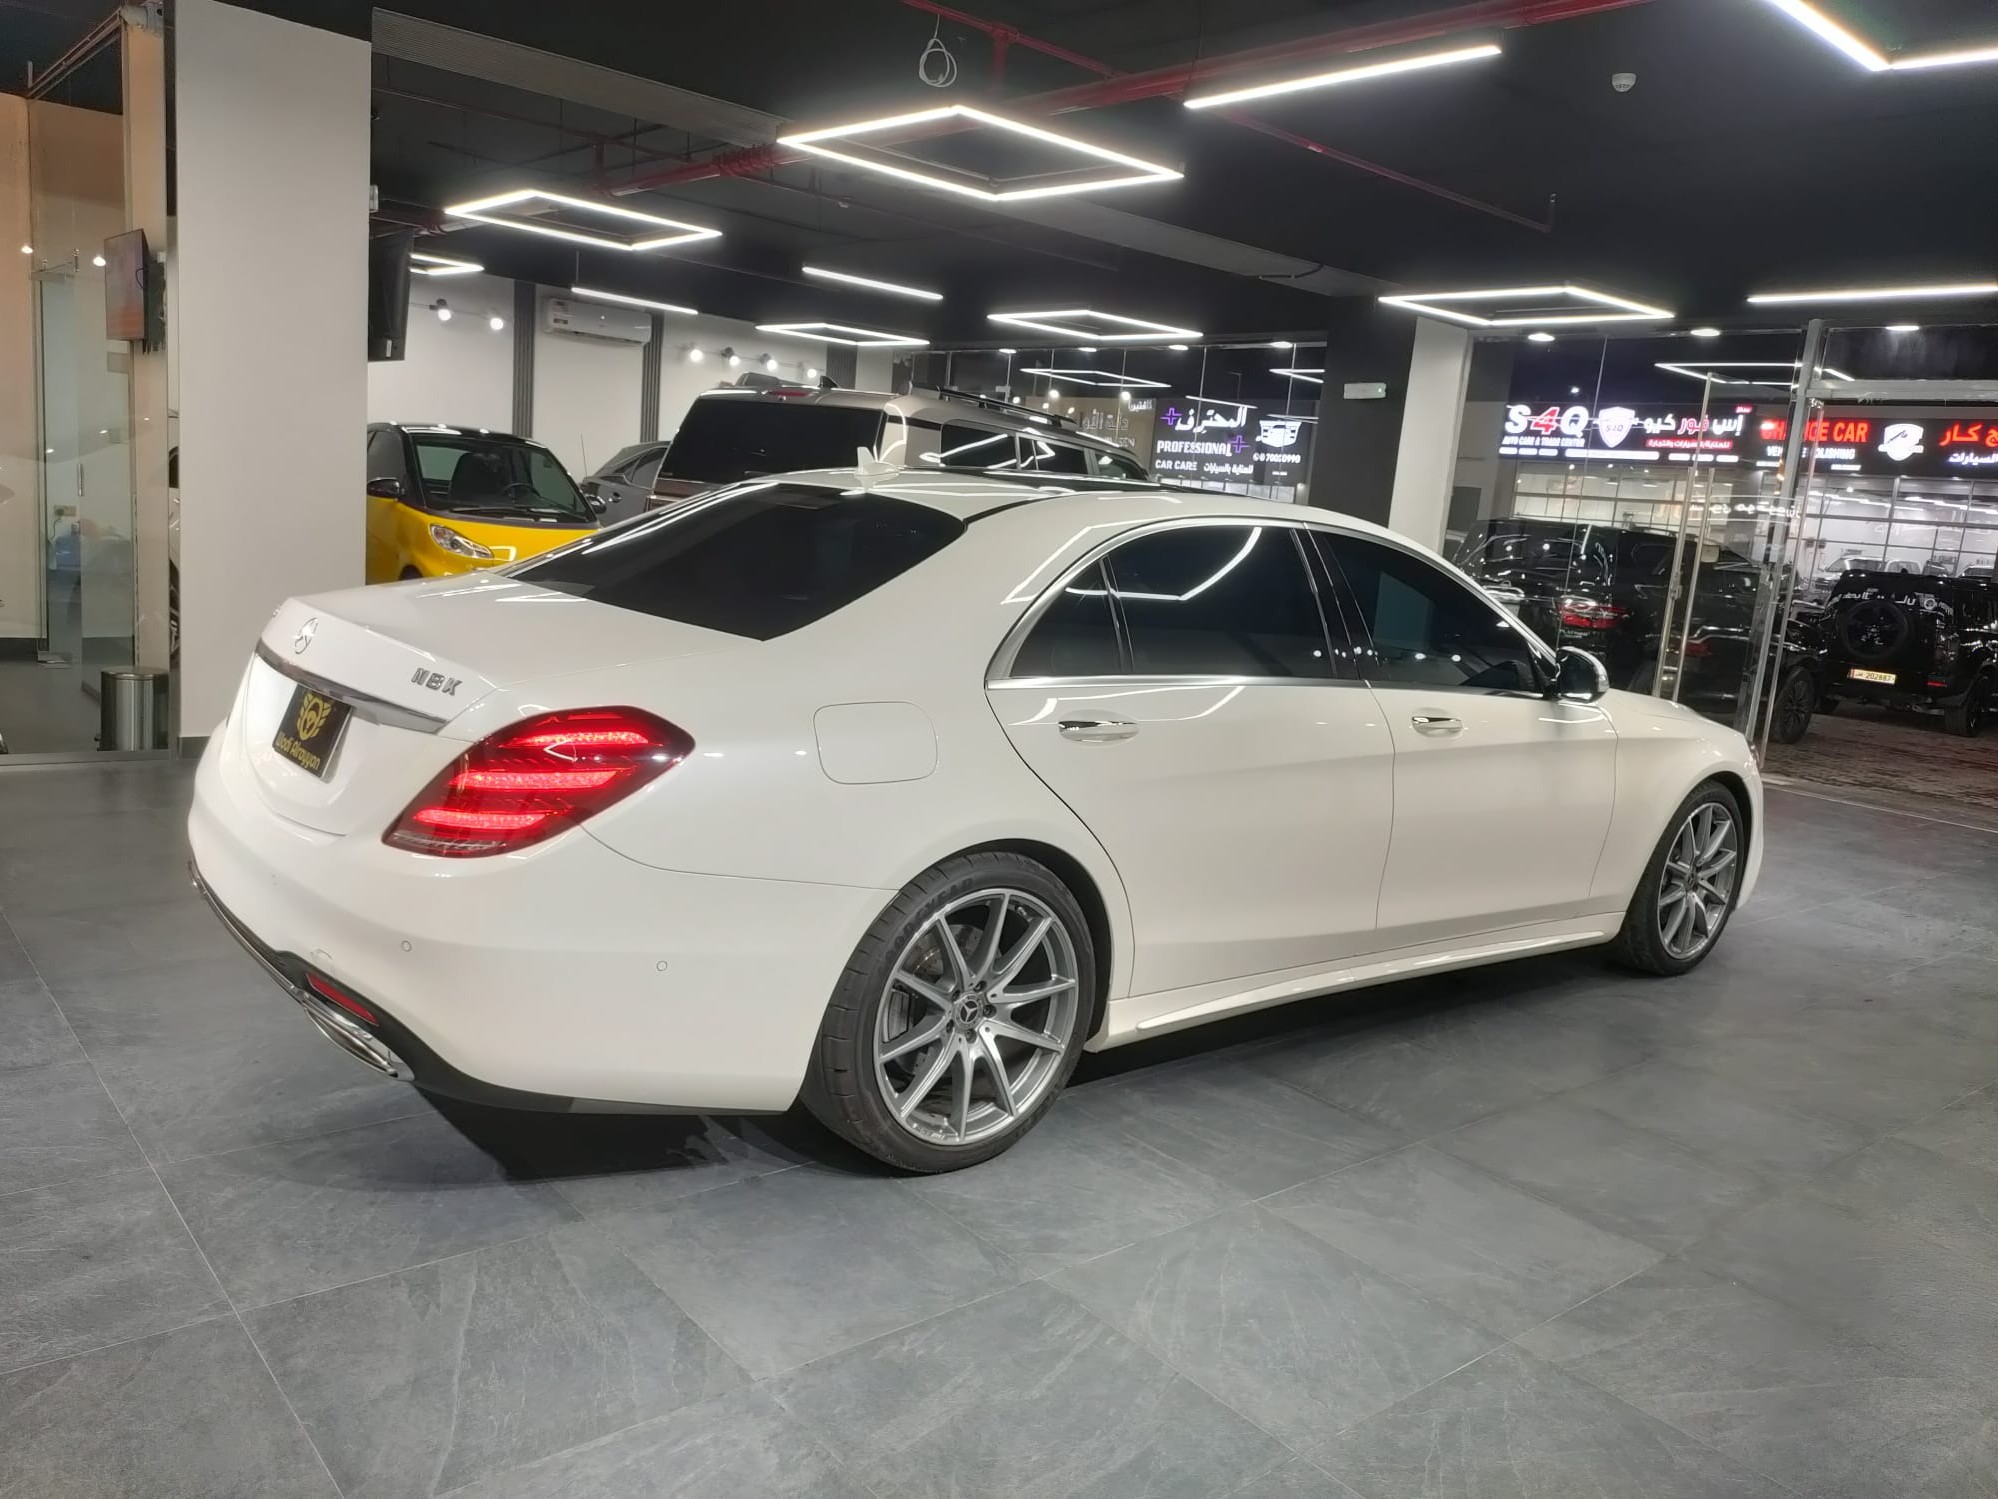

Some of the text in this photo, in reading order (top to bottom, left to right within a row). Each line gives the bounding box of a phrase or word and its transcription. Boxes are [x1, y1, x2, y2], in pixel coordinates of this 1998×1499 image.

[1175, 406, 1247, 434] المحترف
[1504, 404, 1589, 438] S4Q
[1833, 421, 1868, 442] CAR
[1939, 423, 1983, 446] كار
[1156, 440, 1233, 457] PROFESSIONAL
[1155, 459, 1198, 471] CAR CARE
[410, 667, 464, 696] NBK
